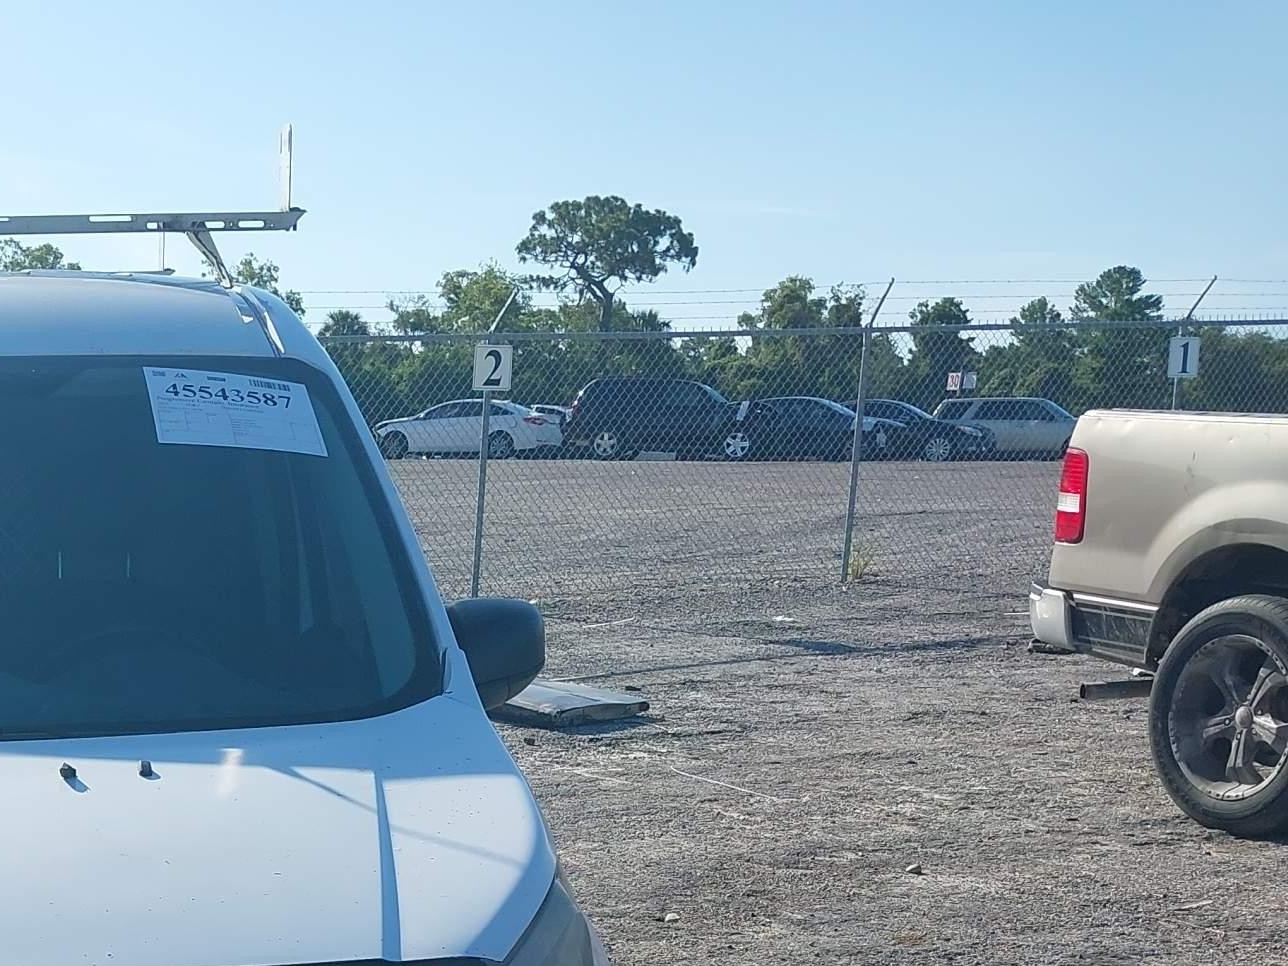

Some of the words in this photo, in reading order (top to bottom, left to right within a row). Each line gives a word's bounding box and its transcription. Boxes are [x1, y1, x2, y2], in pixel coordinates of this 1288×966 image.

[482, 349, 503, 386] 2
[1177, 341, 1191, 374] 1
[165, 383, 291, 409] 45543587
